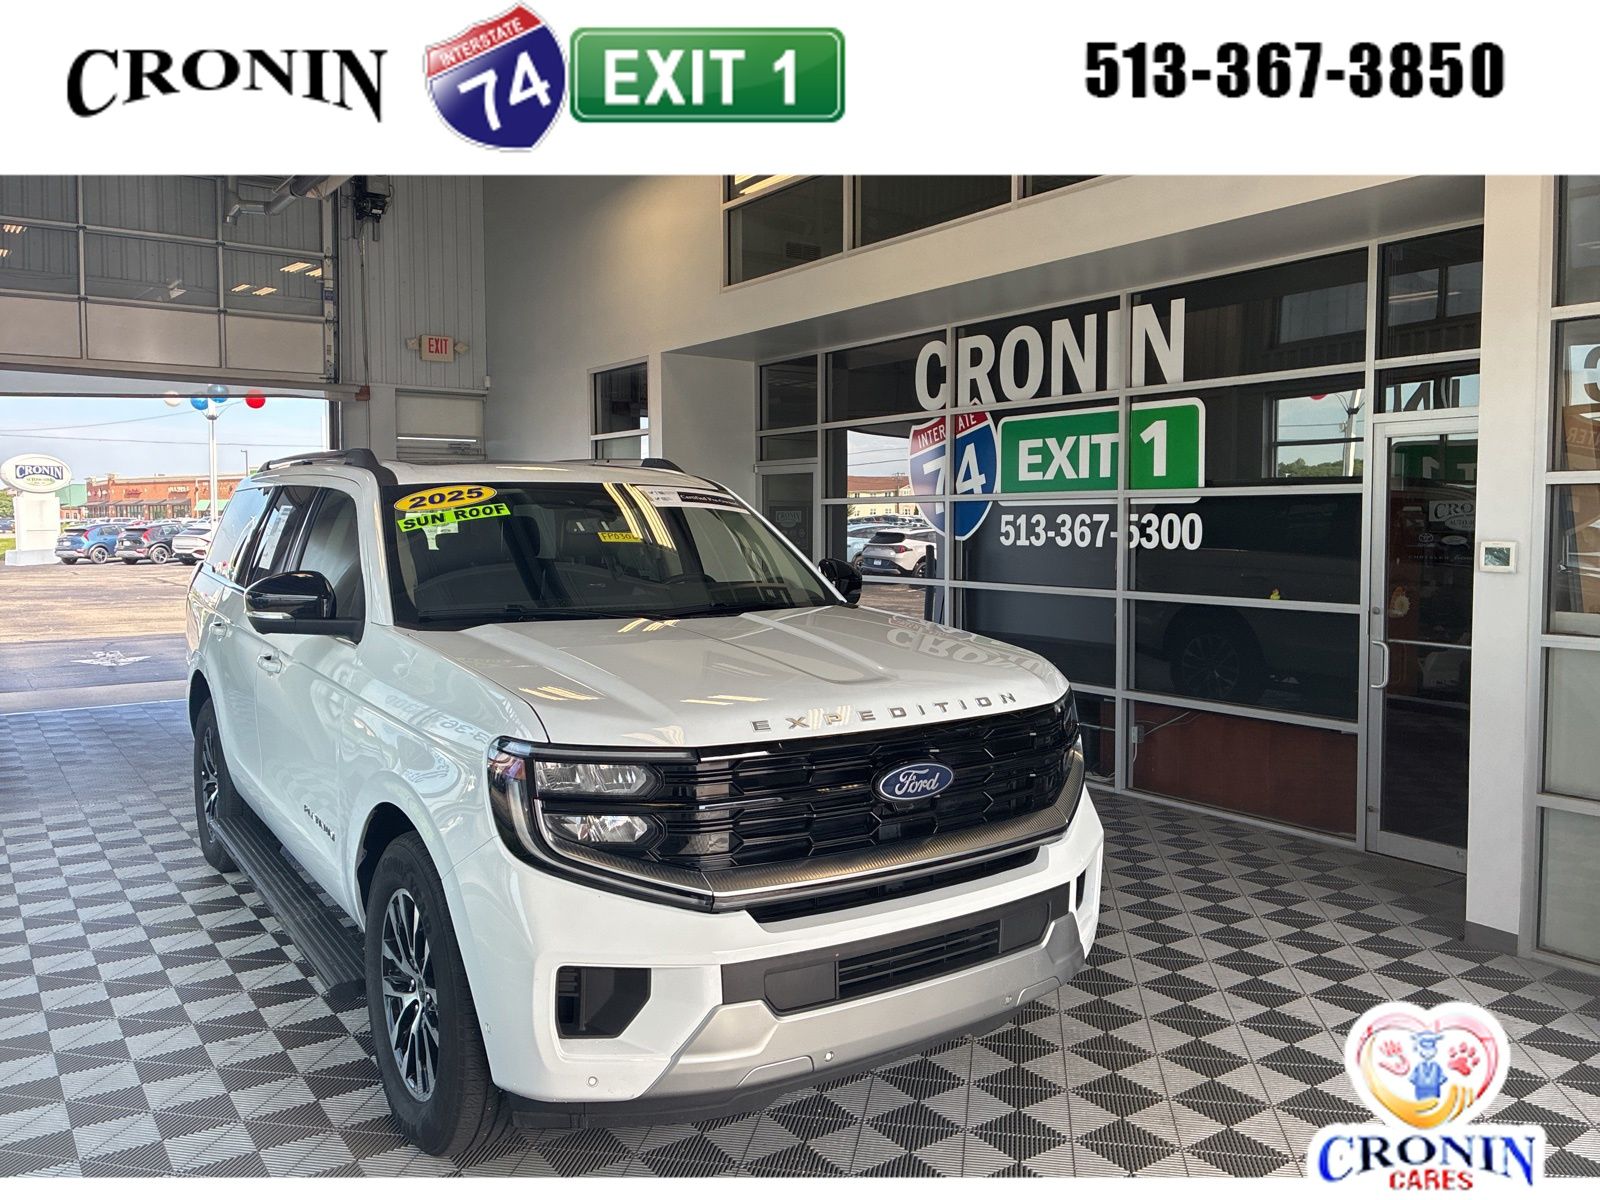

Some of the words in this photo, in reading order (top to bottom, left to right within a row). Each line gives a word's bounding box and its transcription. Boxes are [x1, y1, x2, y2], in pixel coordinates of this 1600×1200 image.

[428, 337, 449, 354] EXIT
[914, 297, 1186, 412] CRONIN
[1017, 432, 1120, 482] EXIT
[1139, 419, 1168, 477] 1
[15, 465, 63, 480] CRONIN
[922, 442, 987, 515] 74
[408, 487, 484, 510] 2025
[403, 512, 445, 530] SUN
[454, 504, 509, 522] ROOF
[999, 512, 1204, 551] 513-367-5300
[751, 692, 1018, 733] EXPEDITION
[894, 767, 940, 796] Ford
